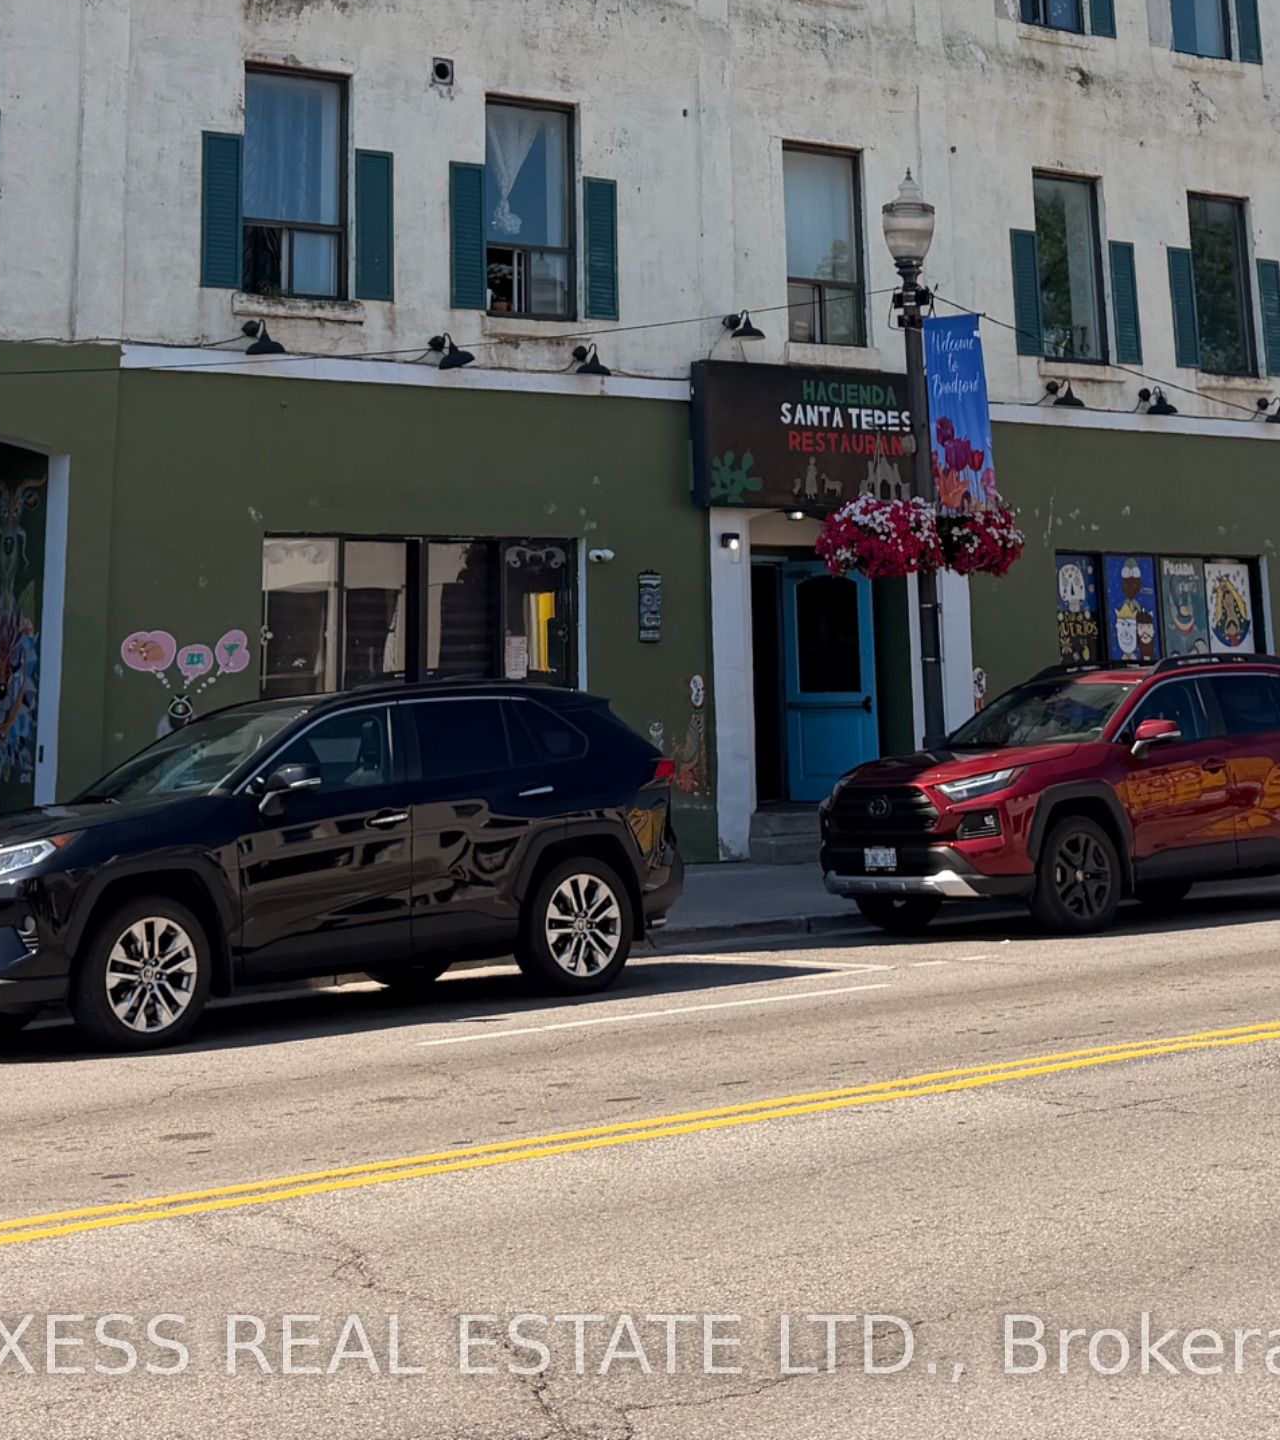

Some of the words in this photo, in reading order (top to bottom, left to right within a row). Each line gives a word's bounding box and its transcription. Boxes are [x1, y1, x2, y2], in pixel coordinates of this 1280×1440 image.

[930, 330, 974, 354] Welcome
[802, 379, 897, 406] HACIENDA
[931, 371, 980, 401] Bradford
[781, 402, 844, 428] SANTA
[788, 431, 905, 456] RESTAURAN
